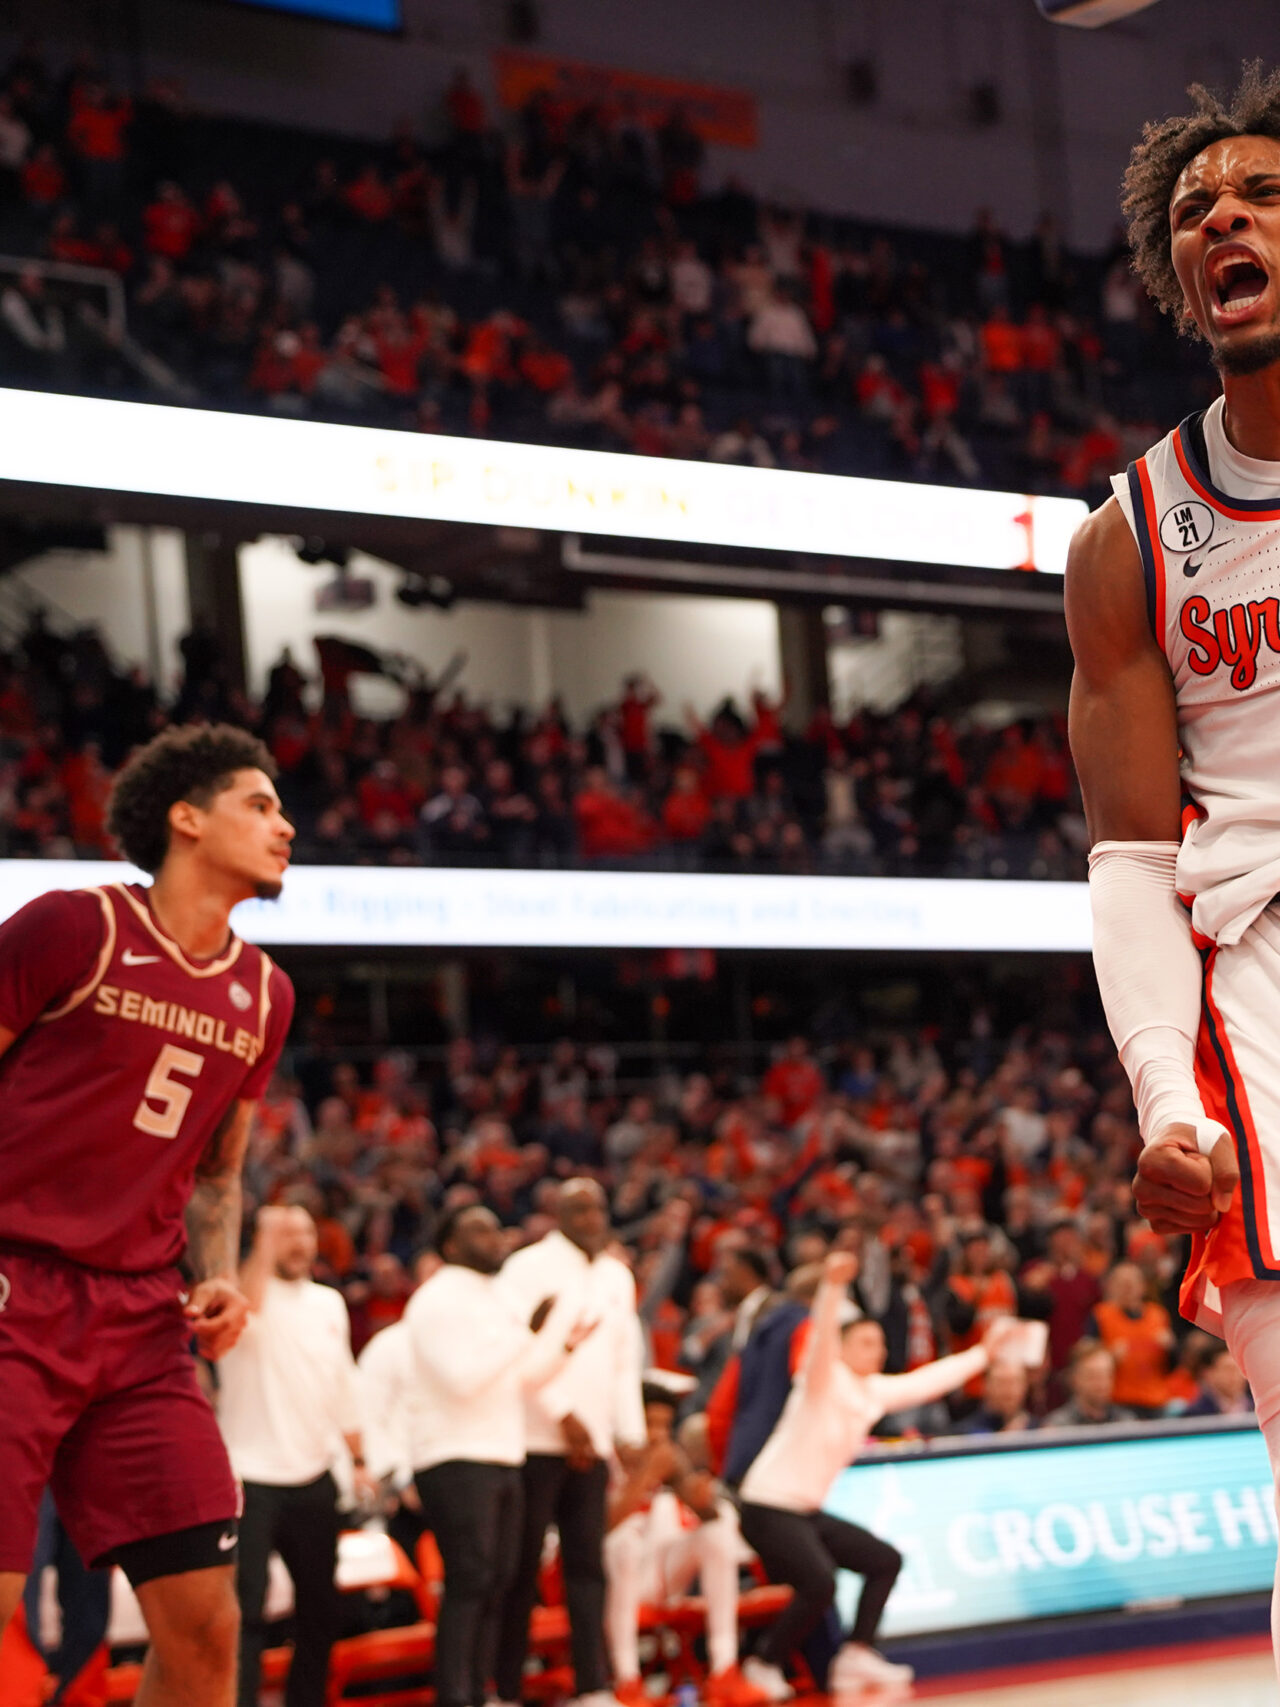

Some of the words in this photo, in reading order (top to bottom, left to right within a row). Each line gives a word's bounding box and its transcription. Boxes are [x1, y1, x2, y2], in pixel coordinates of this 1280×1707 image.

[1173, 507, 1193, 526] LM
[1178, 522, 1200, 547] 21
[132, 1043, 205, 1139] 5
[949, 1491, 1213, 1577] CROUSE
